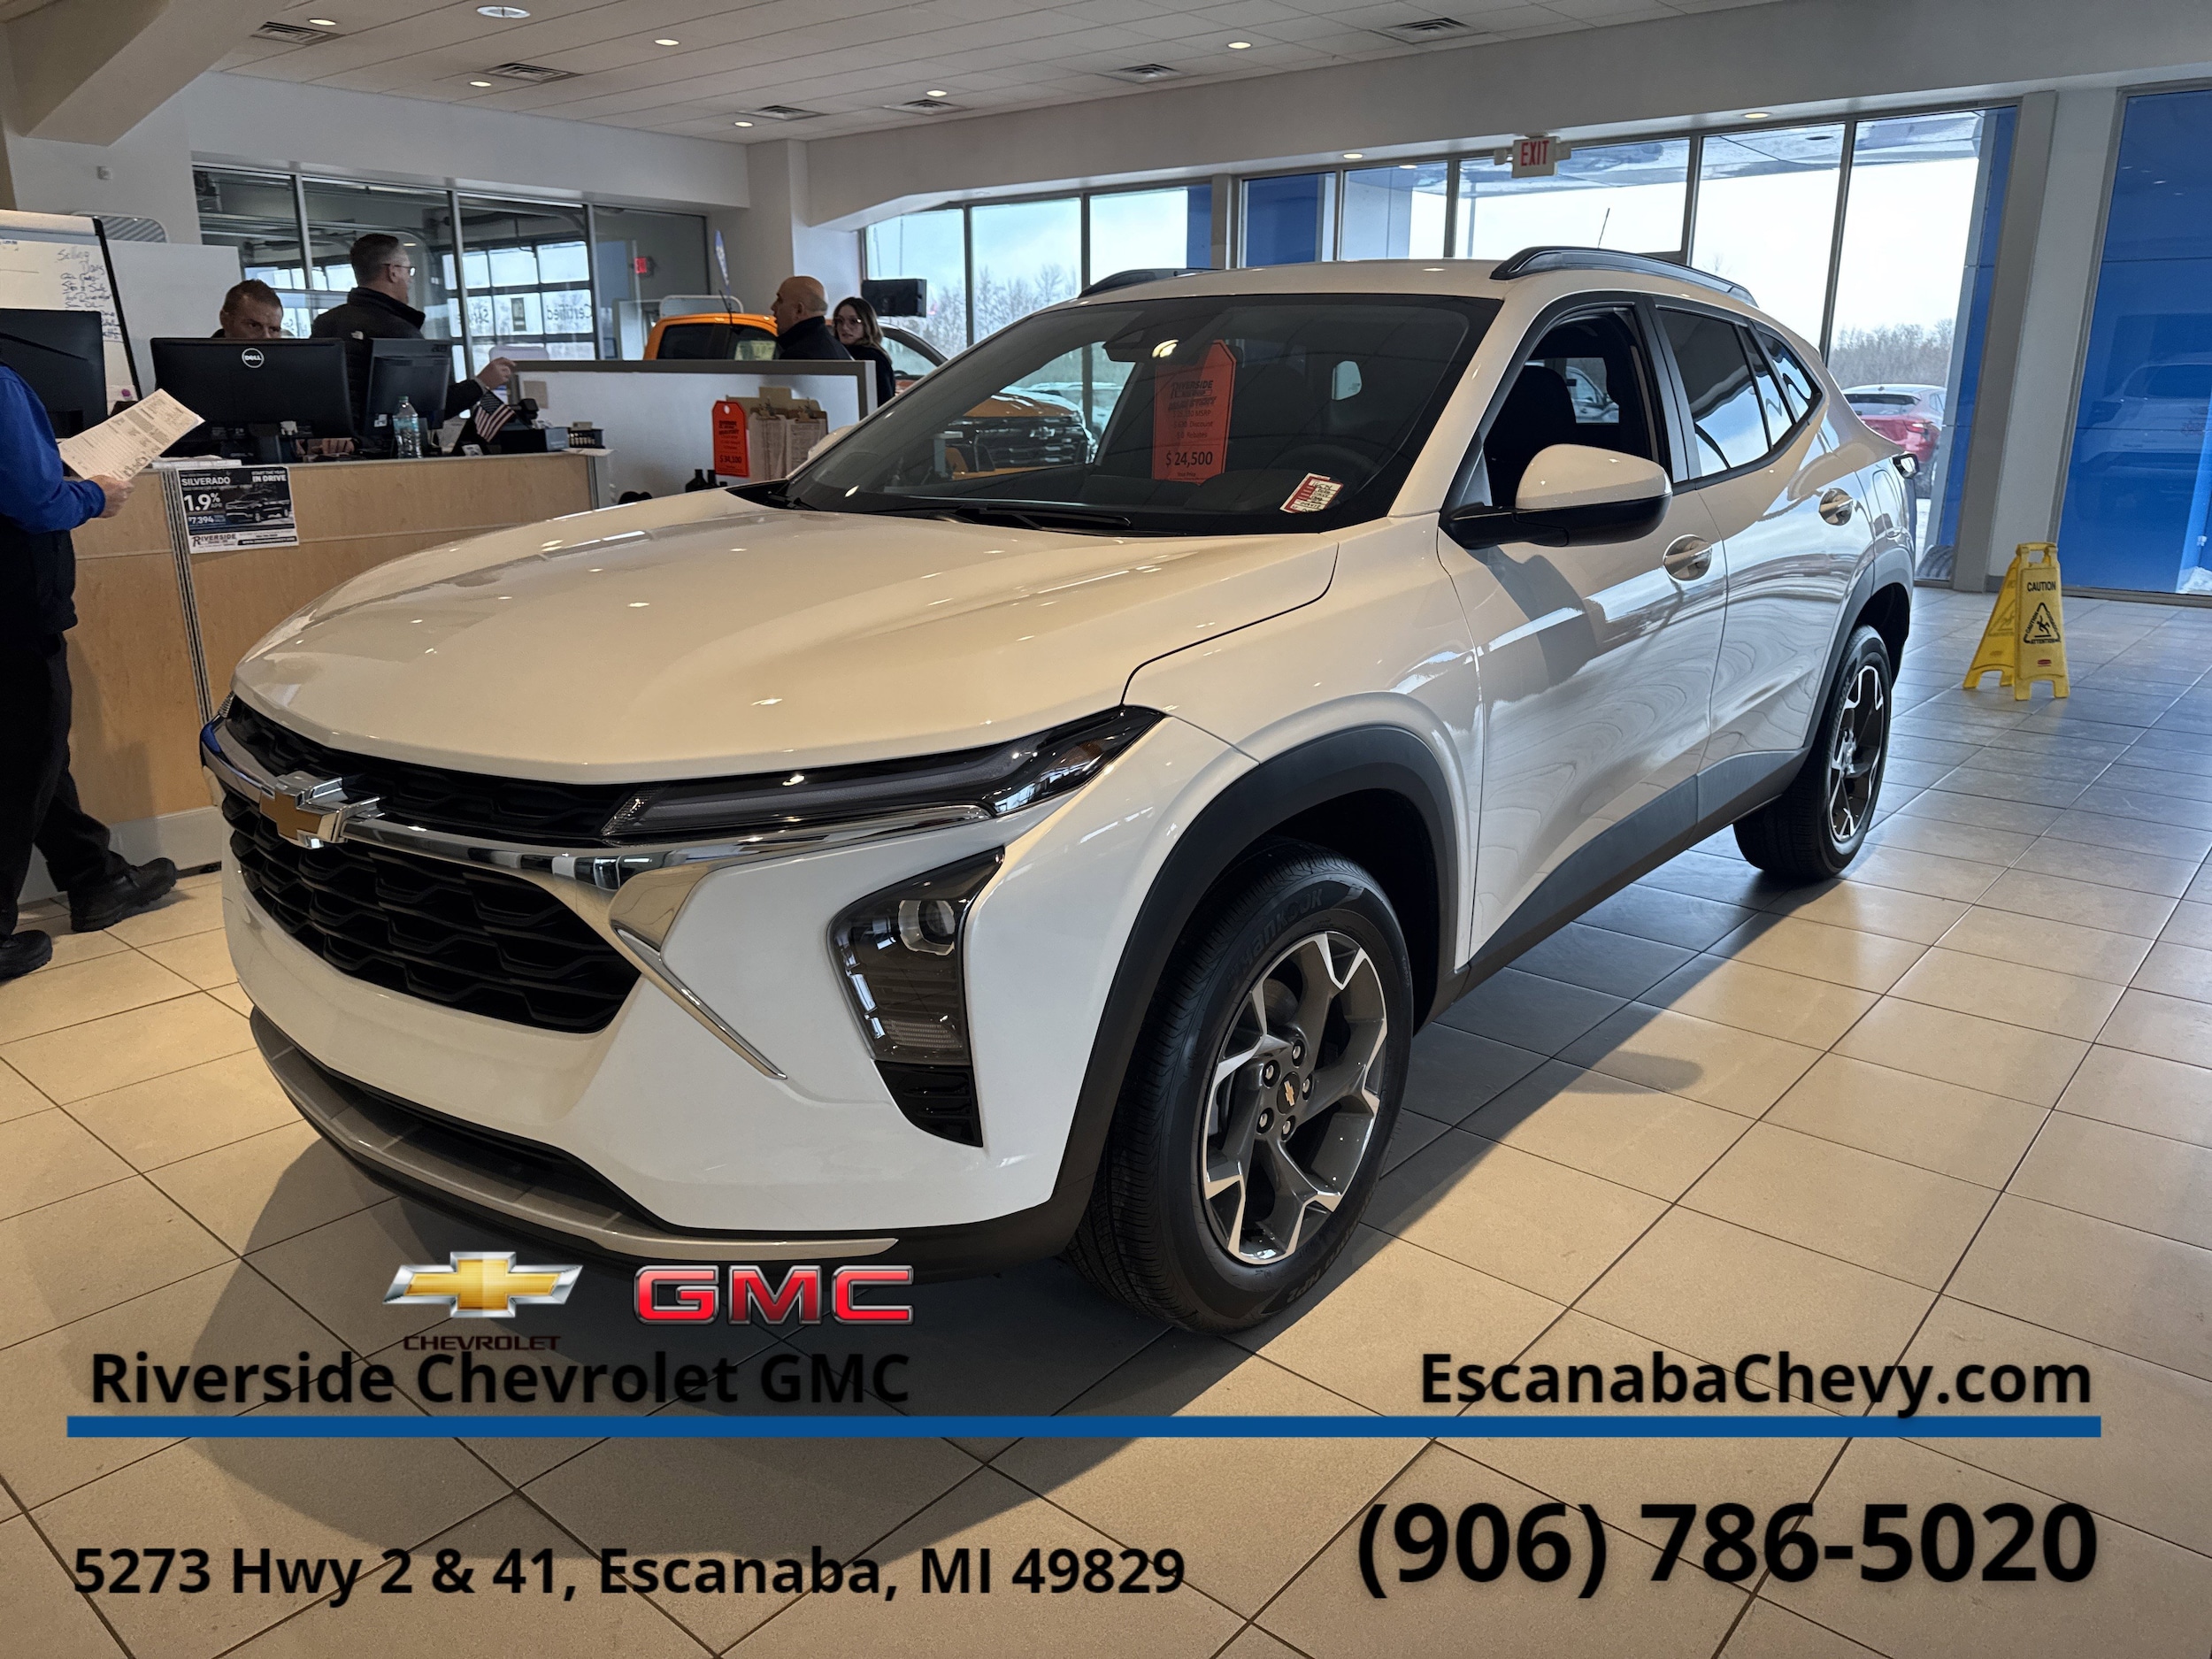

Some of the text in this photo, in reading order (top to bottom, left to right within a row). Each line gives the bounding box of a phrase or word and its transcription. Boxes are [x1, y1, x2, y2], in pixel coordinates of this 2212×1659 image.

[1520, 140, 1550, 166] EXIT
[180, 476, 231, 487] SILVERADO
[262, 473, 287, 482] DRIVE
[191, 533, 236, 548] RIVERSIDE
[2027, 580, 2056, 592] CAUTION
[2025, 611, 2039, 634] CAUTION
